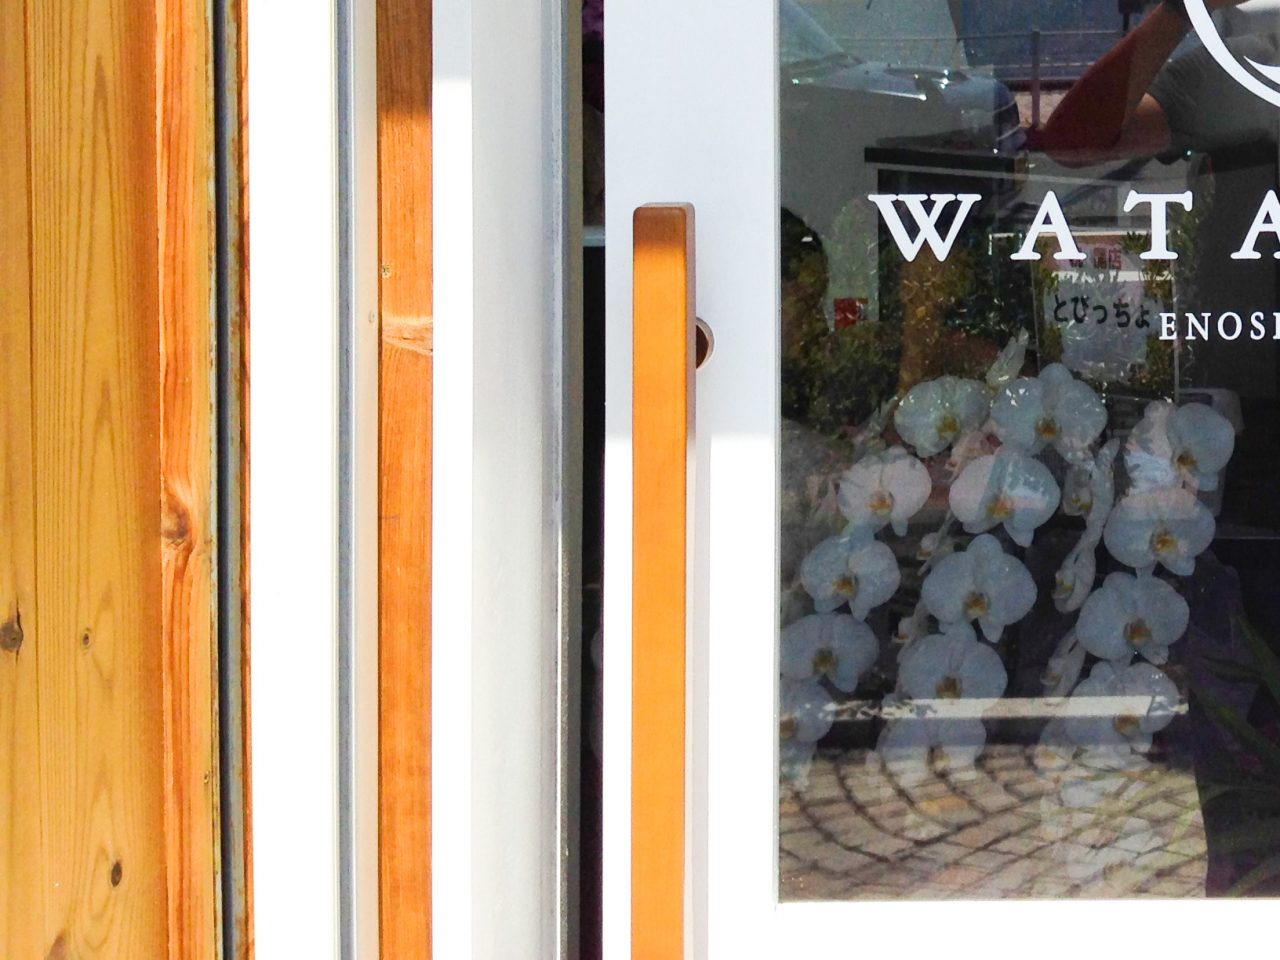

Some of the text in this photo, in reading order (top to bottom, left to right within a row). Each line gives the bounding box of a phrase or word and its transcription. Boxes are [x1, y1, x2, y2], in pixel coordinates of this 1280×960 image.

[1052, 294, 1151, 329] とびっちょ
